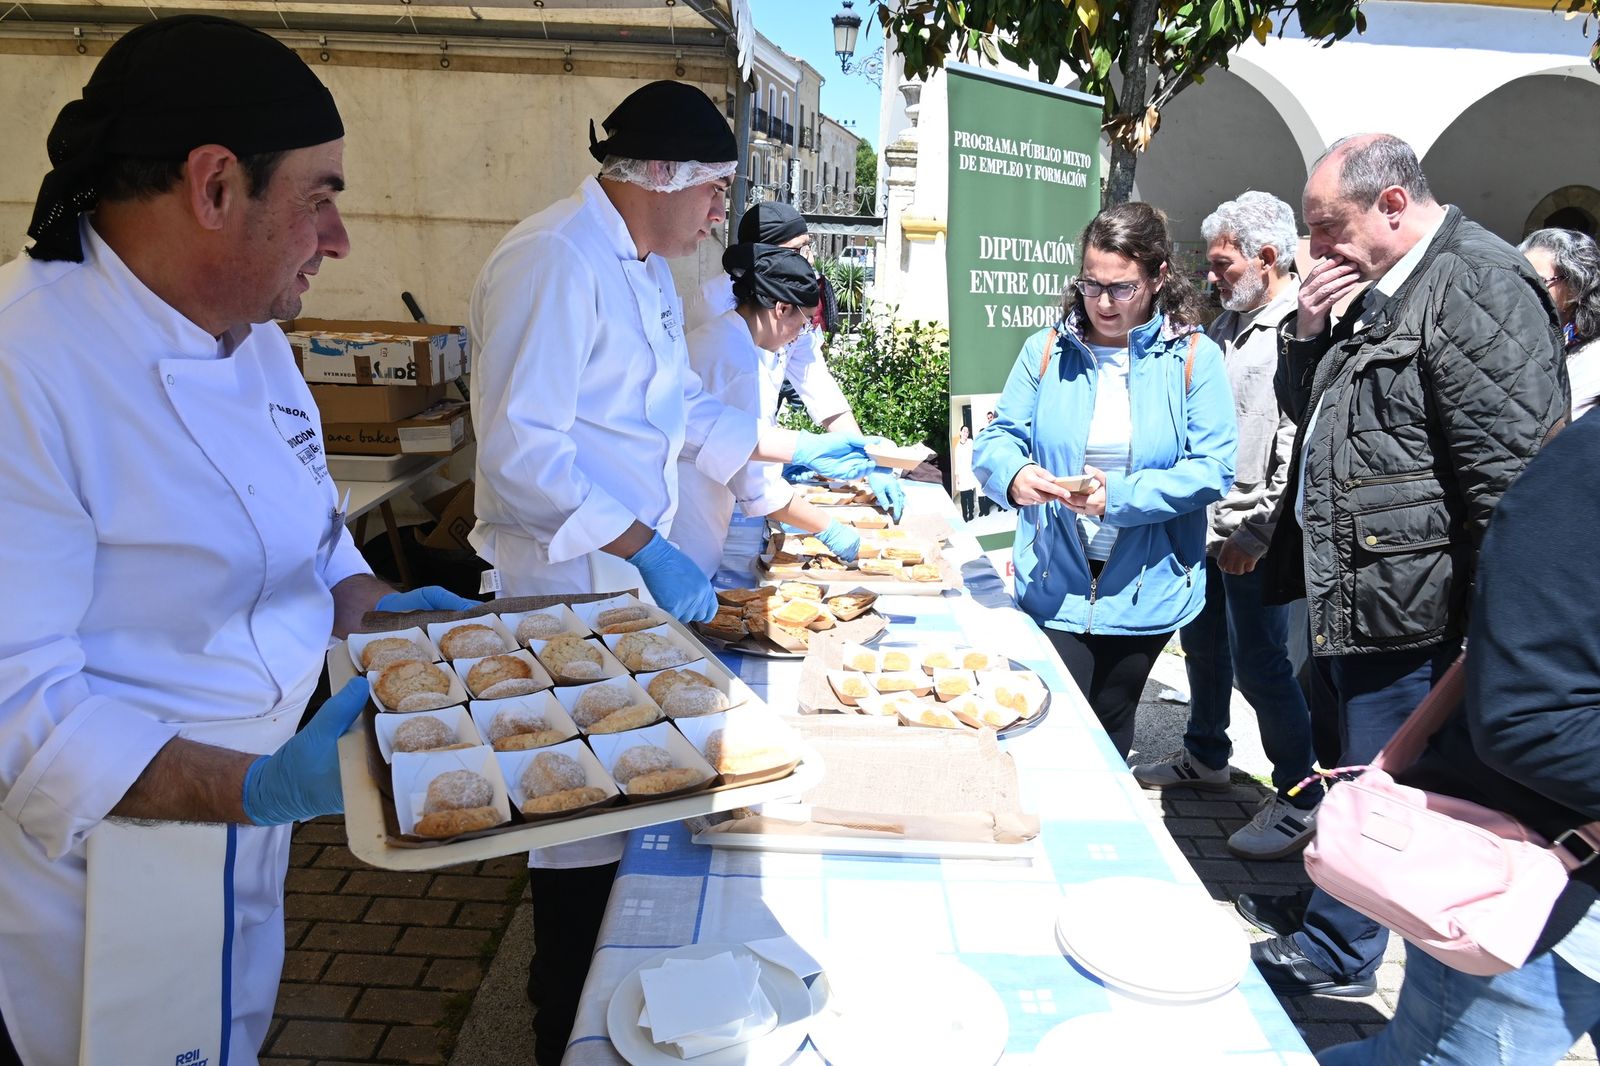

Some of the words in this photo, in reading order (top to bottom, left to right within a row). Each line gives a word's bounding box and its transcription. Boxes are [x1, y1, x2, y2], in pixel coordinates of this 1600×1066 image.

[953, 130, 1018, 156] PROGRAMA
[1019, 139, 1062, 163] PÚBLICO
[1063, 152, 1092, 169] MIXTO
[959, 153, 977, 171] DE
[978, 156, 1024, 178] EMPLEO
[1025, 164, 1034, 179] Y
[1034, 165, 1087, 188] FORMACIÓN
[979, 235, 1075, 265] DIPUTACIÓN
[969, 269, 1029, 295] ENTRE
[984, 304, 998, 328] Y
[1001, 305, 1064, 328] SABORE
